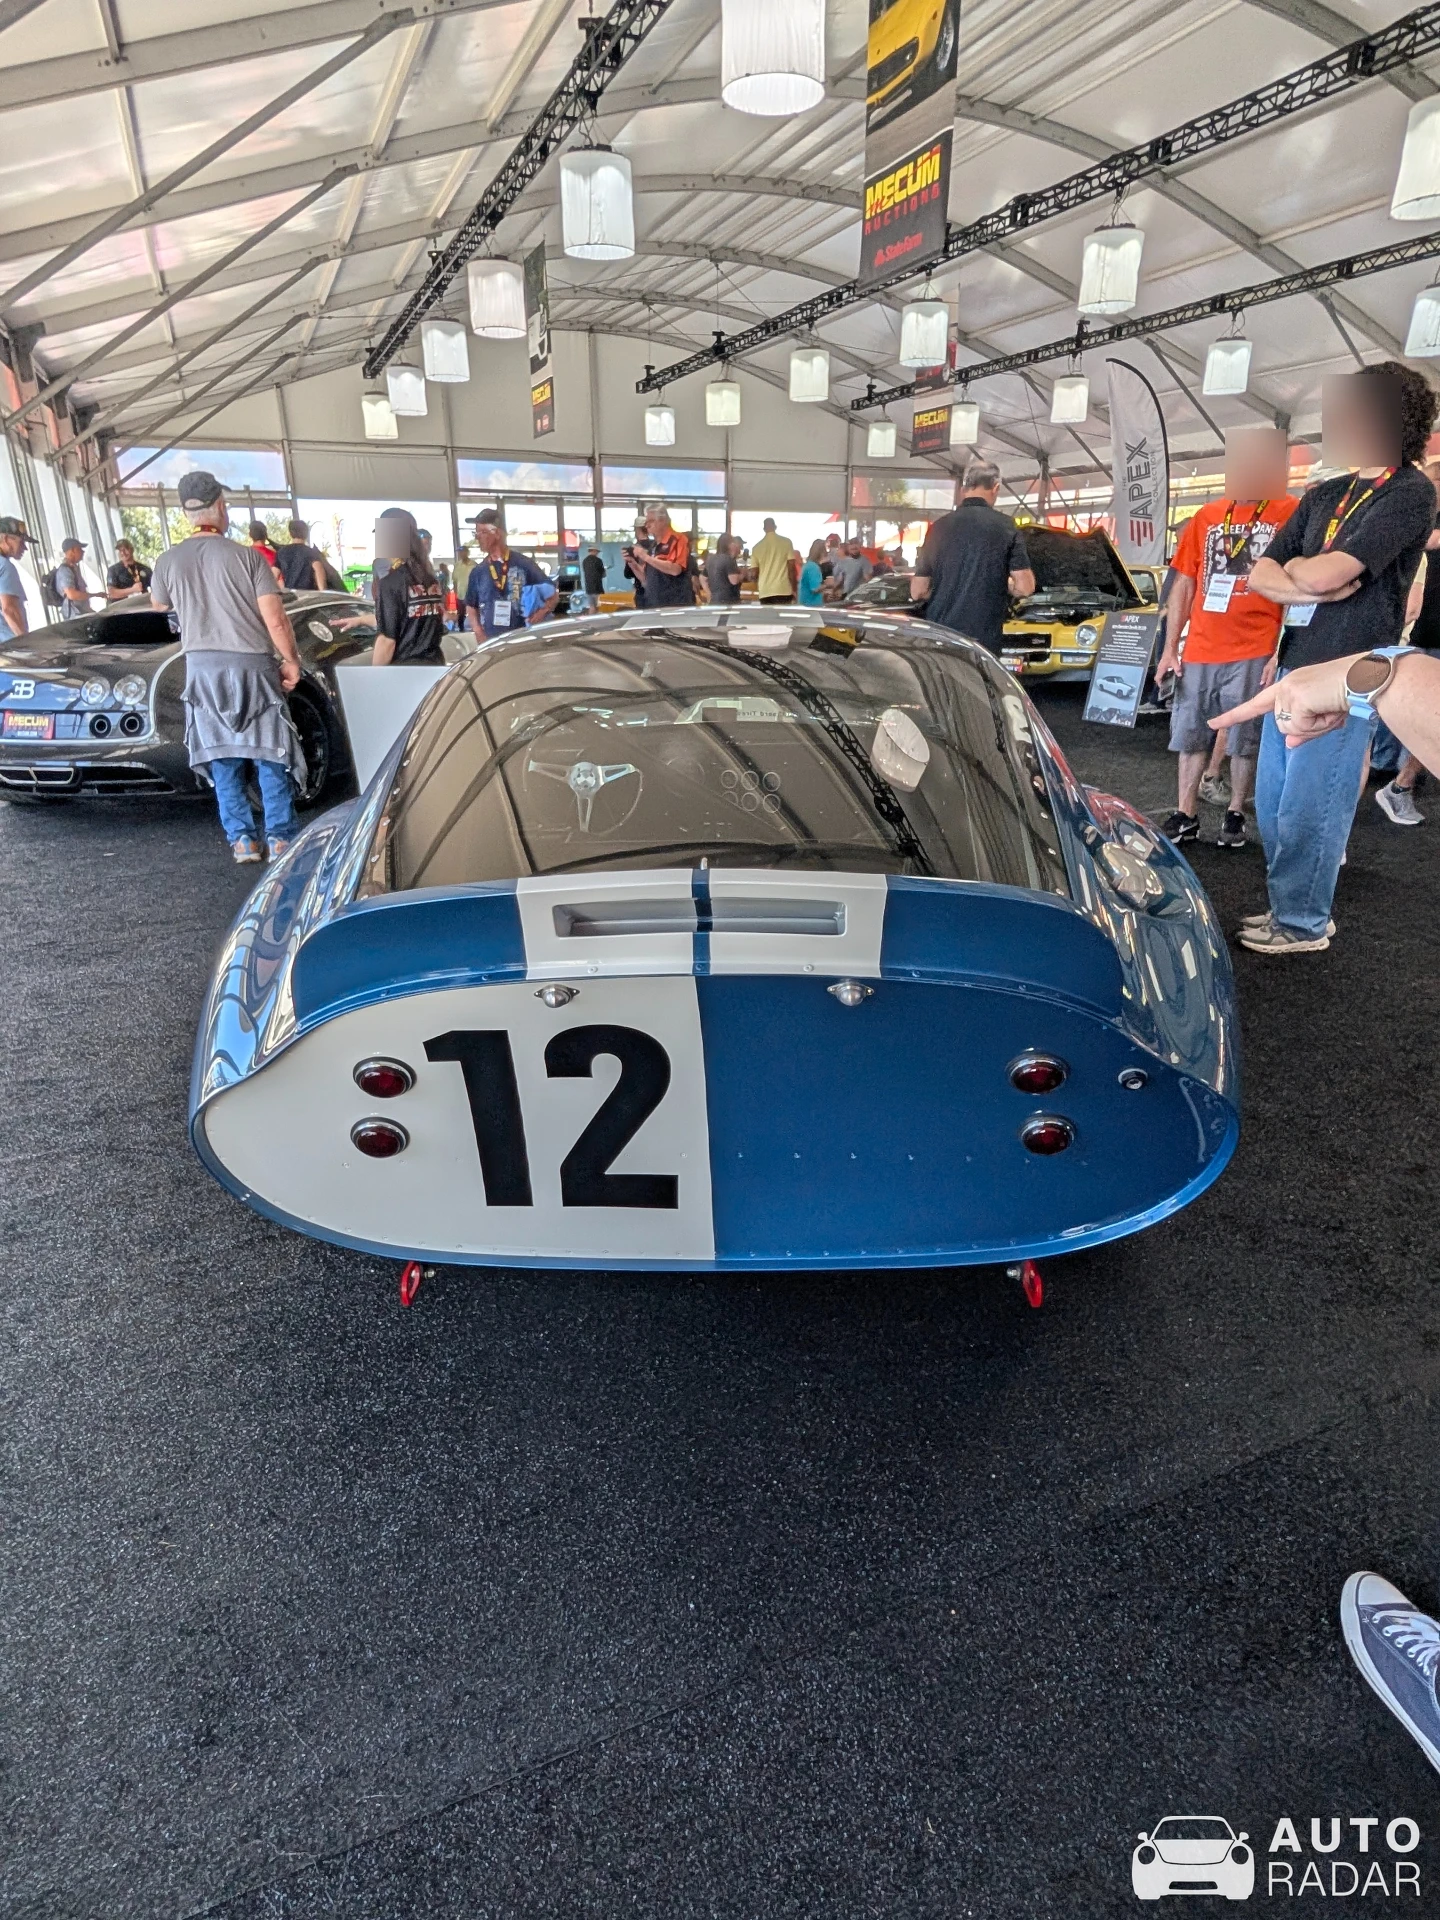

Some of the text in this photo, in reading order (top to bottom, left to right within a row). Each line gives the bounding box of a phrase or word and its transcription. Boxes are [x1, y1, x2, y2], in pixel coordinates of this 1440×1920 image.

[865, 143, 941, 219] MECUM
[865, 182, 940, 235] AUCTIONS
[1125, 437, 1152, 520] APEX
[1125, 615, 1140, 623] APEX
[8, 715, 48, 726] MECUM
[422, 1023, 679, 1210] 12
